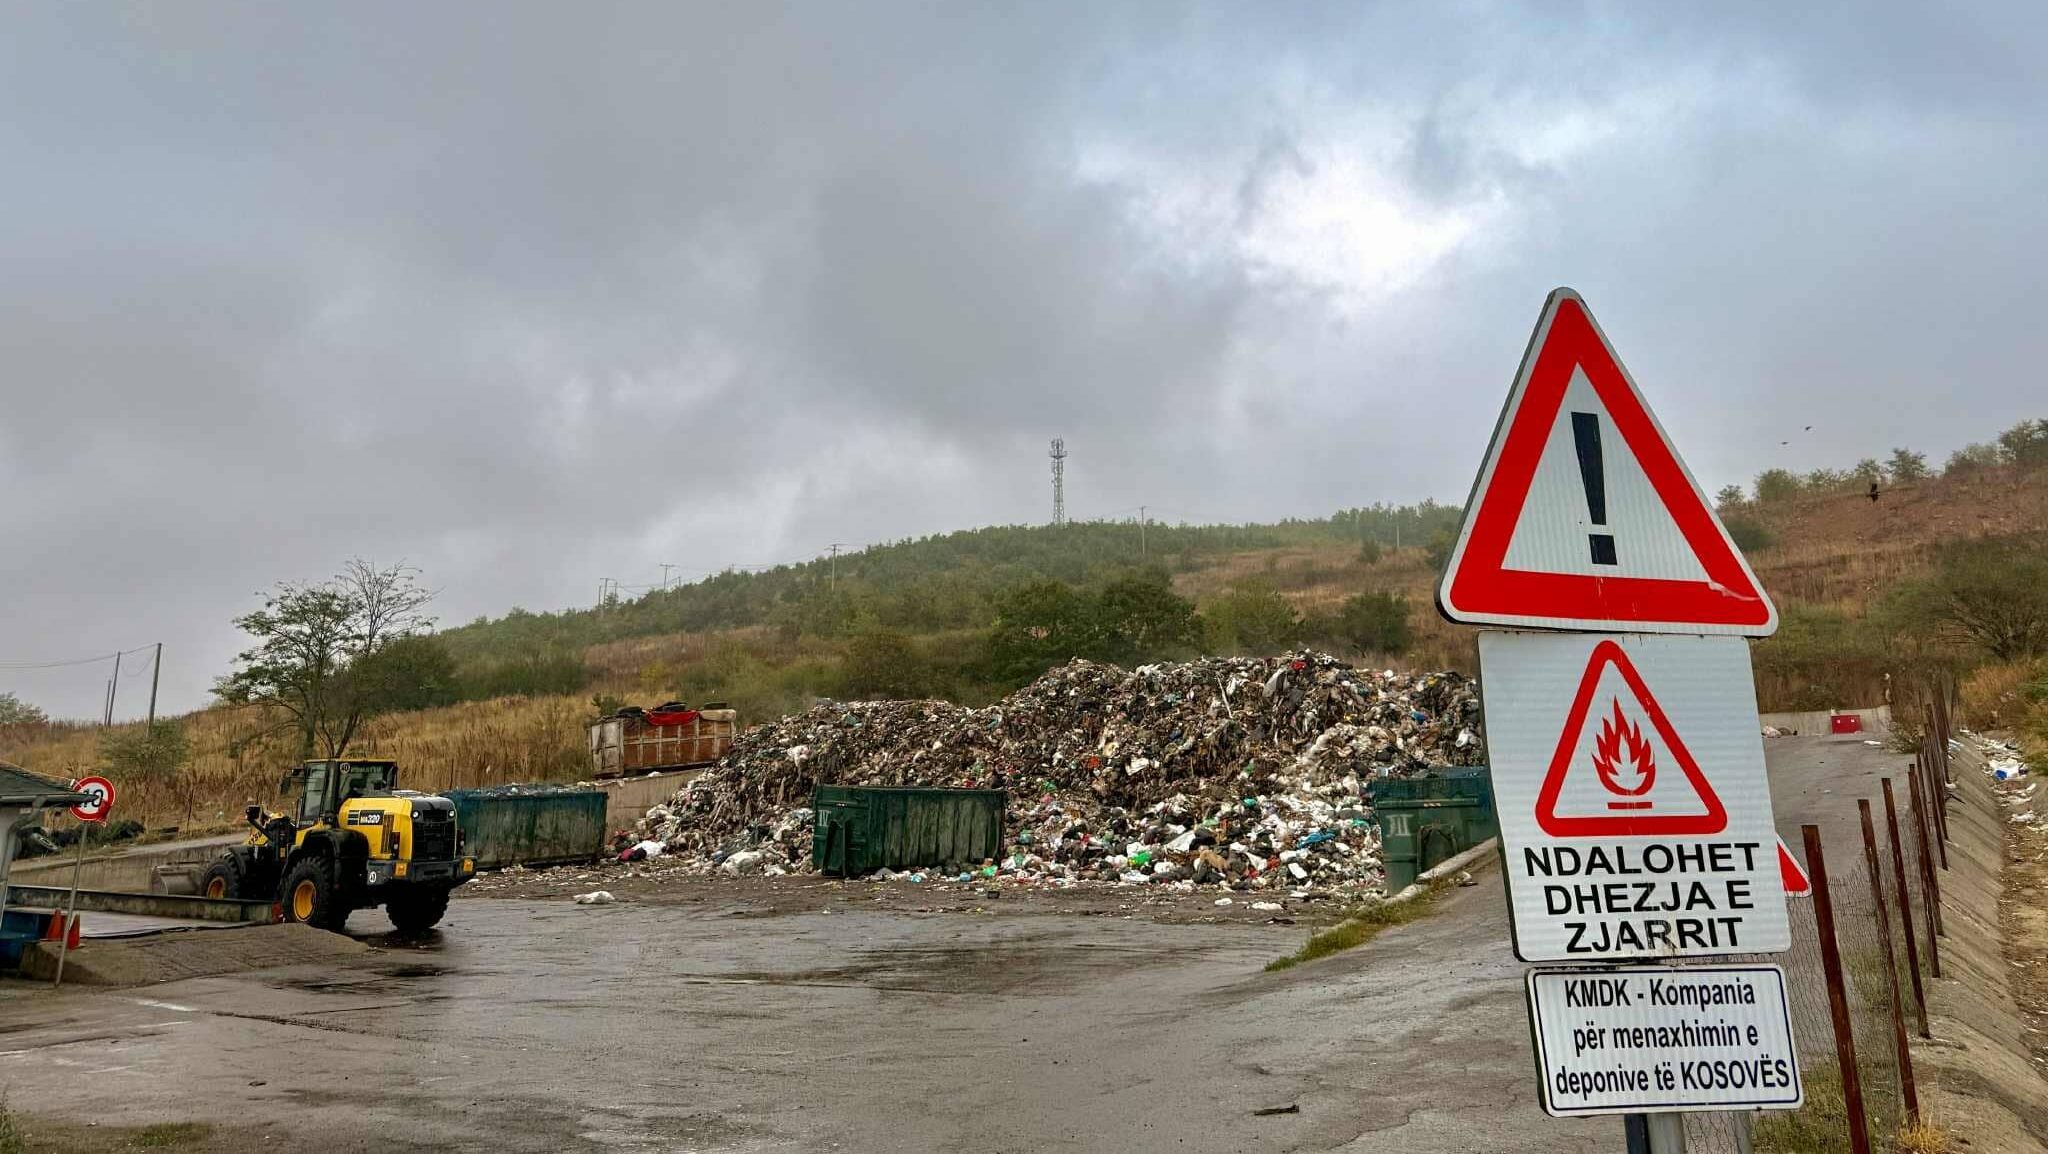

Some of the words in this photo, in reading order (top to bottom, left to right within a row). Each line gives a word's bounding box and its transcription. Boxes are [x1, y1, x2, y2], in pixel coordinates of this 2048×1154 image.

[1524, 842, 1760, 877] NDALOHET
[1543, 881, 1716, 915] DHEZJA
[1726, 880, 1754, 909] E
[1564, 917, 1744, 953] ZJARRIT
[1564, 978, 1631, 1008] KMDK
[1649, 977, 1755, 1012] Kompania
[1573, 1021, 1606, 1057] për
[1613, 1018, 1741, 1050] menaxhimin
[1747, 1023, 1759, 1046] e
[1556, 1063, 1649, 1101] deponive
[1655, 1062, 1675, 1091] të
[1680, 1054, 1790, 1090] KOSOVËS
